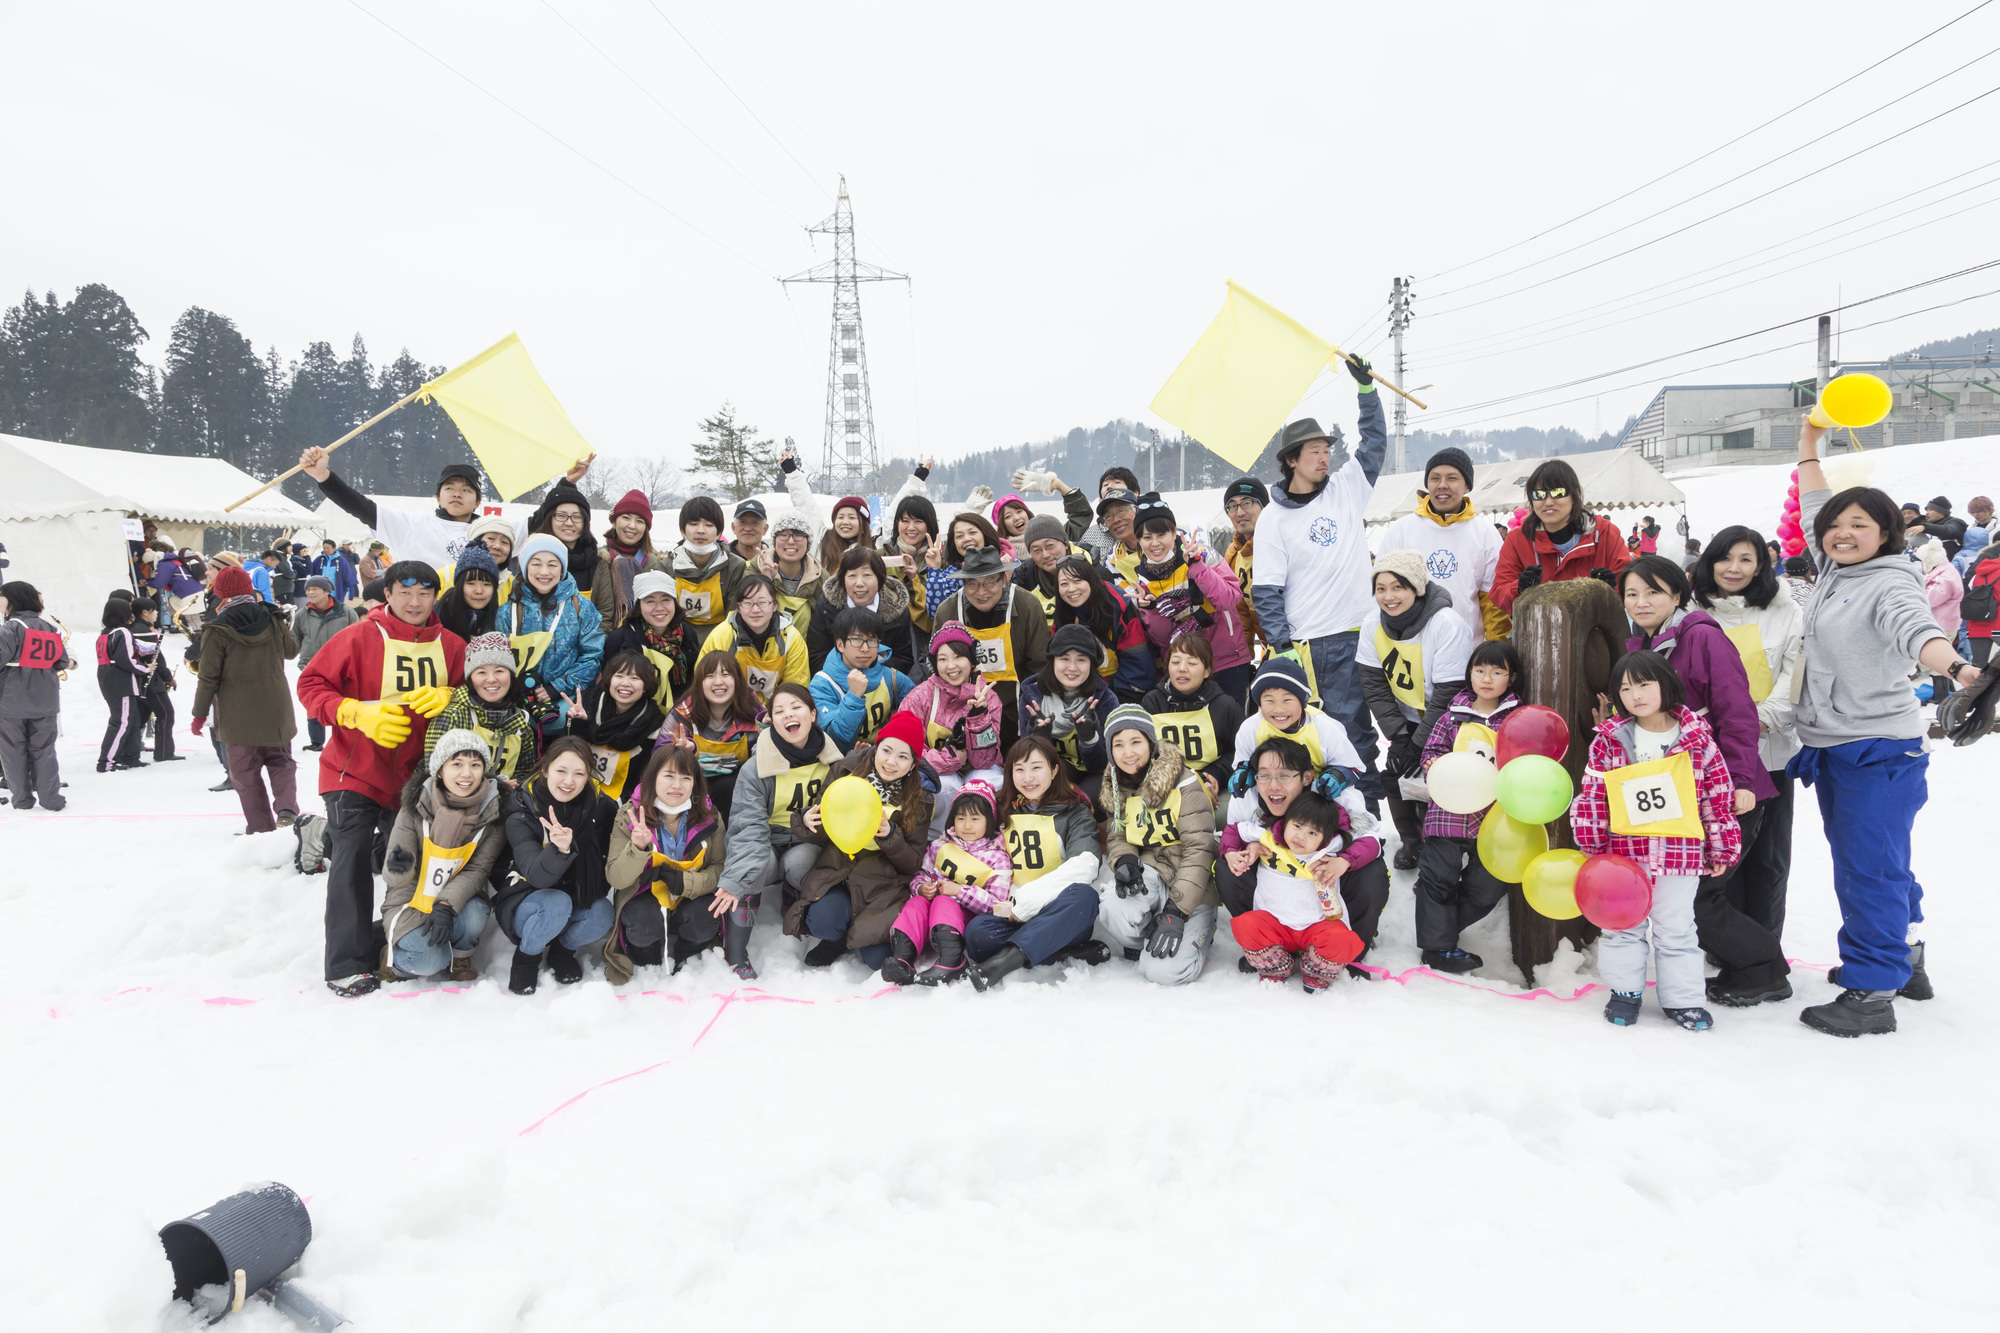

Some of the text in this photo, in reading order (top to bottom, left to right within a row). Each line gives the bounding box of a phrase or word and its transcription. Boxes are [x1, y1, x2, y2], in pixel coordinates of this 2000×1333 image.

[1239, 567, 1253, 599] 2
[685, 598, 702, 612] 64
[30, 638, 56, 661] 20
[396, 654, 437, 692] 50
[1382, 647, 1414, 691] 43
[786, 779, 821, 811] 48
[1636, 787, 1666, 812] 85
[1136, 808, 1180, 847] 23
[1009, 829, 1045, 870] 28
[433, 868, 453, 887] 61
